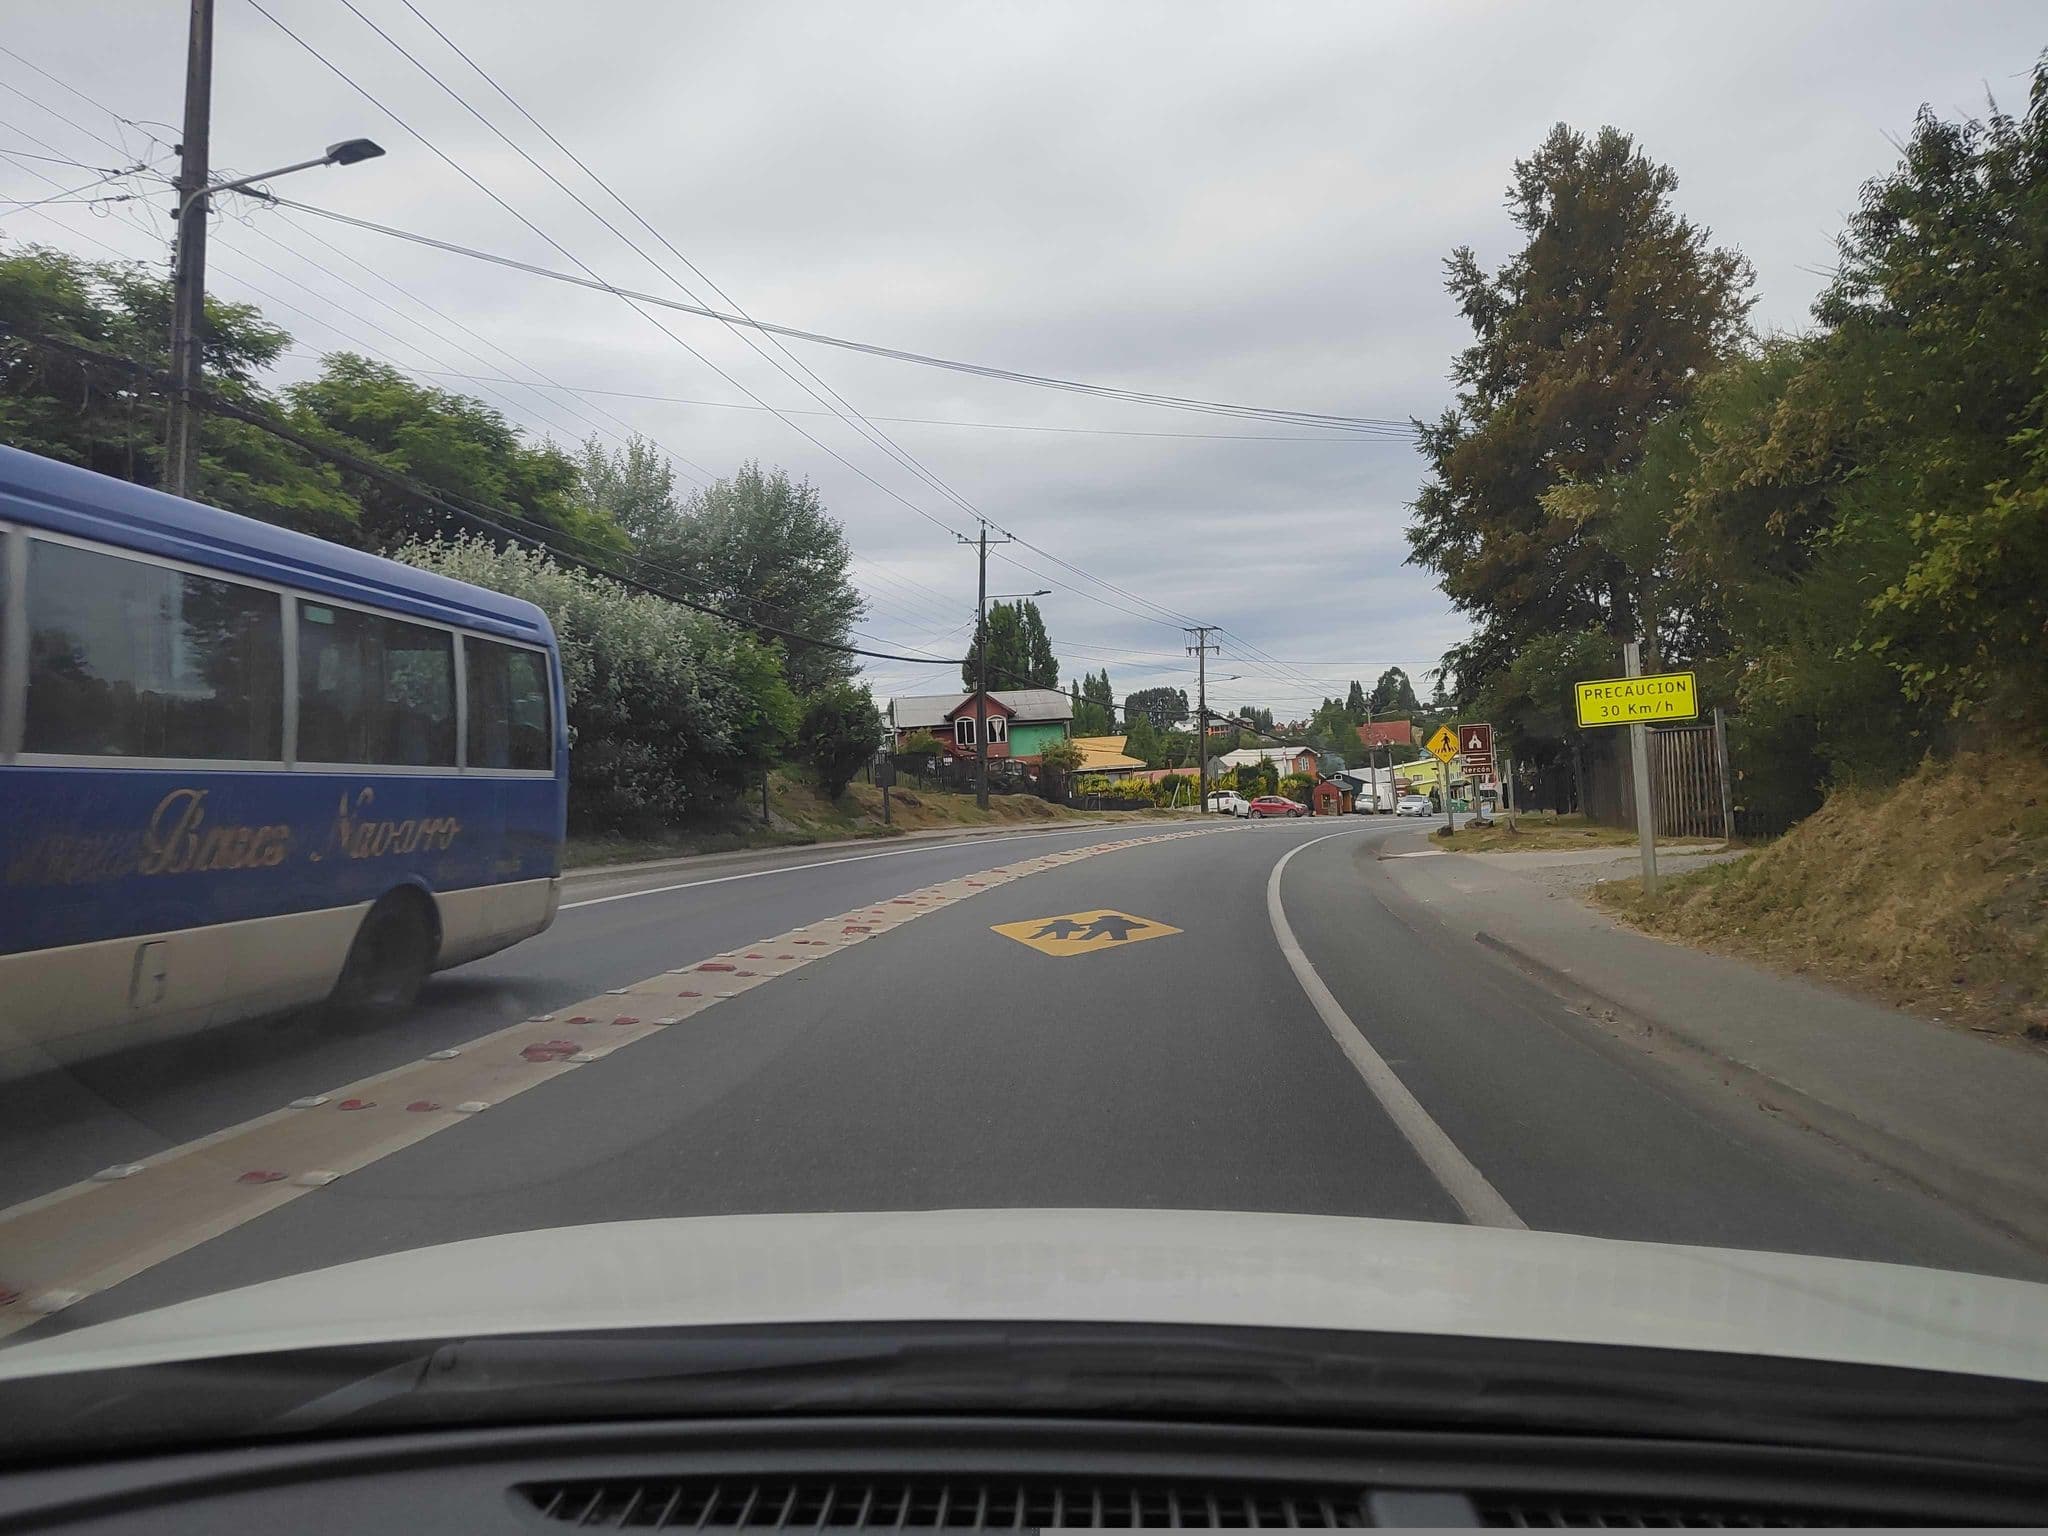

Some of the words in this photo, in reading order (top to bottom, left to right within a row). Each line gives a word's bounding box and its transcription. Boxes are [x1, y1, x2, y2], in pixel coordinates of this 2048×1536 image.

[1584, 681, 1686, 700] PRECAUCION
[1600, 705, 1620, 717] 30
[1628, 701, 1674, 714] Km/h
